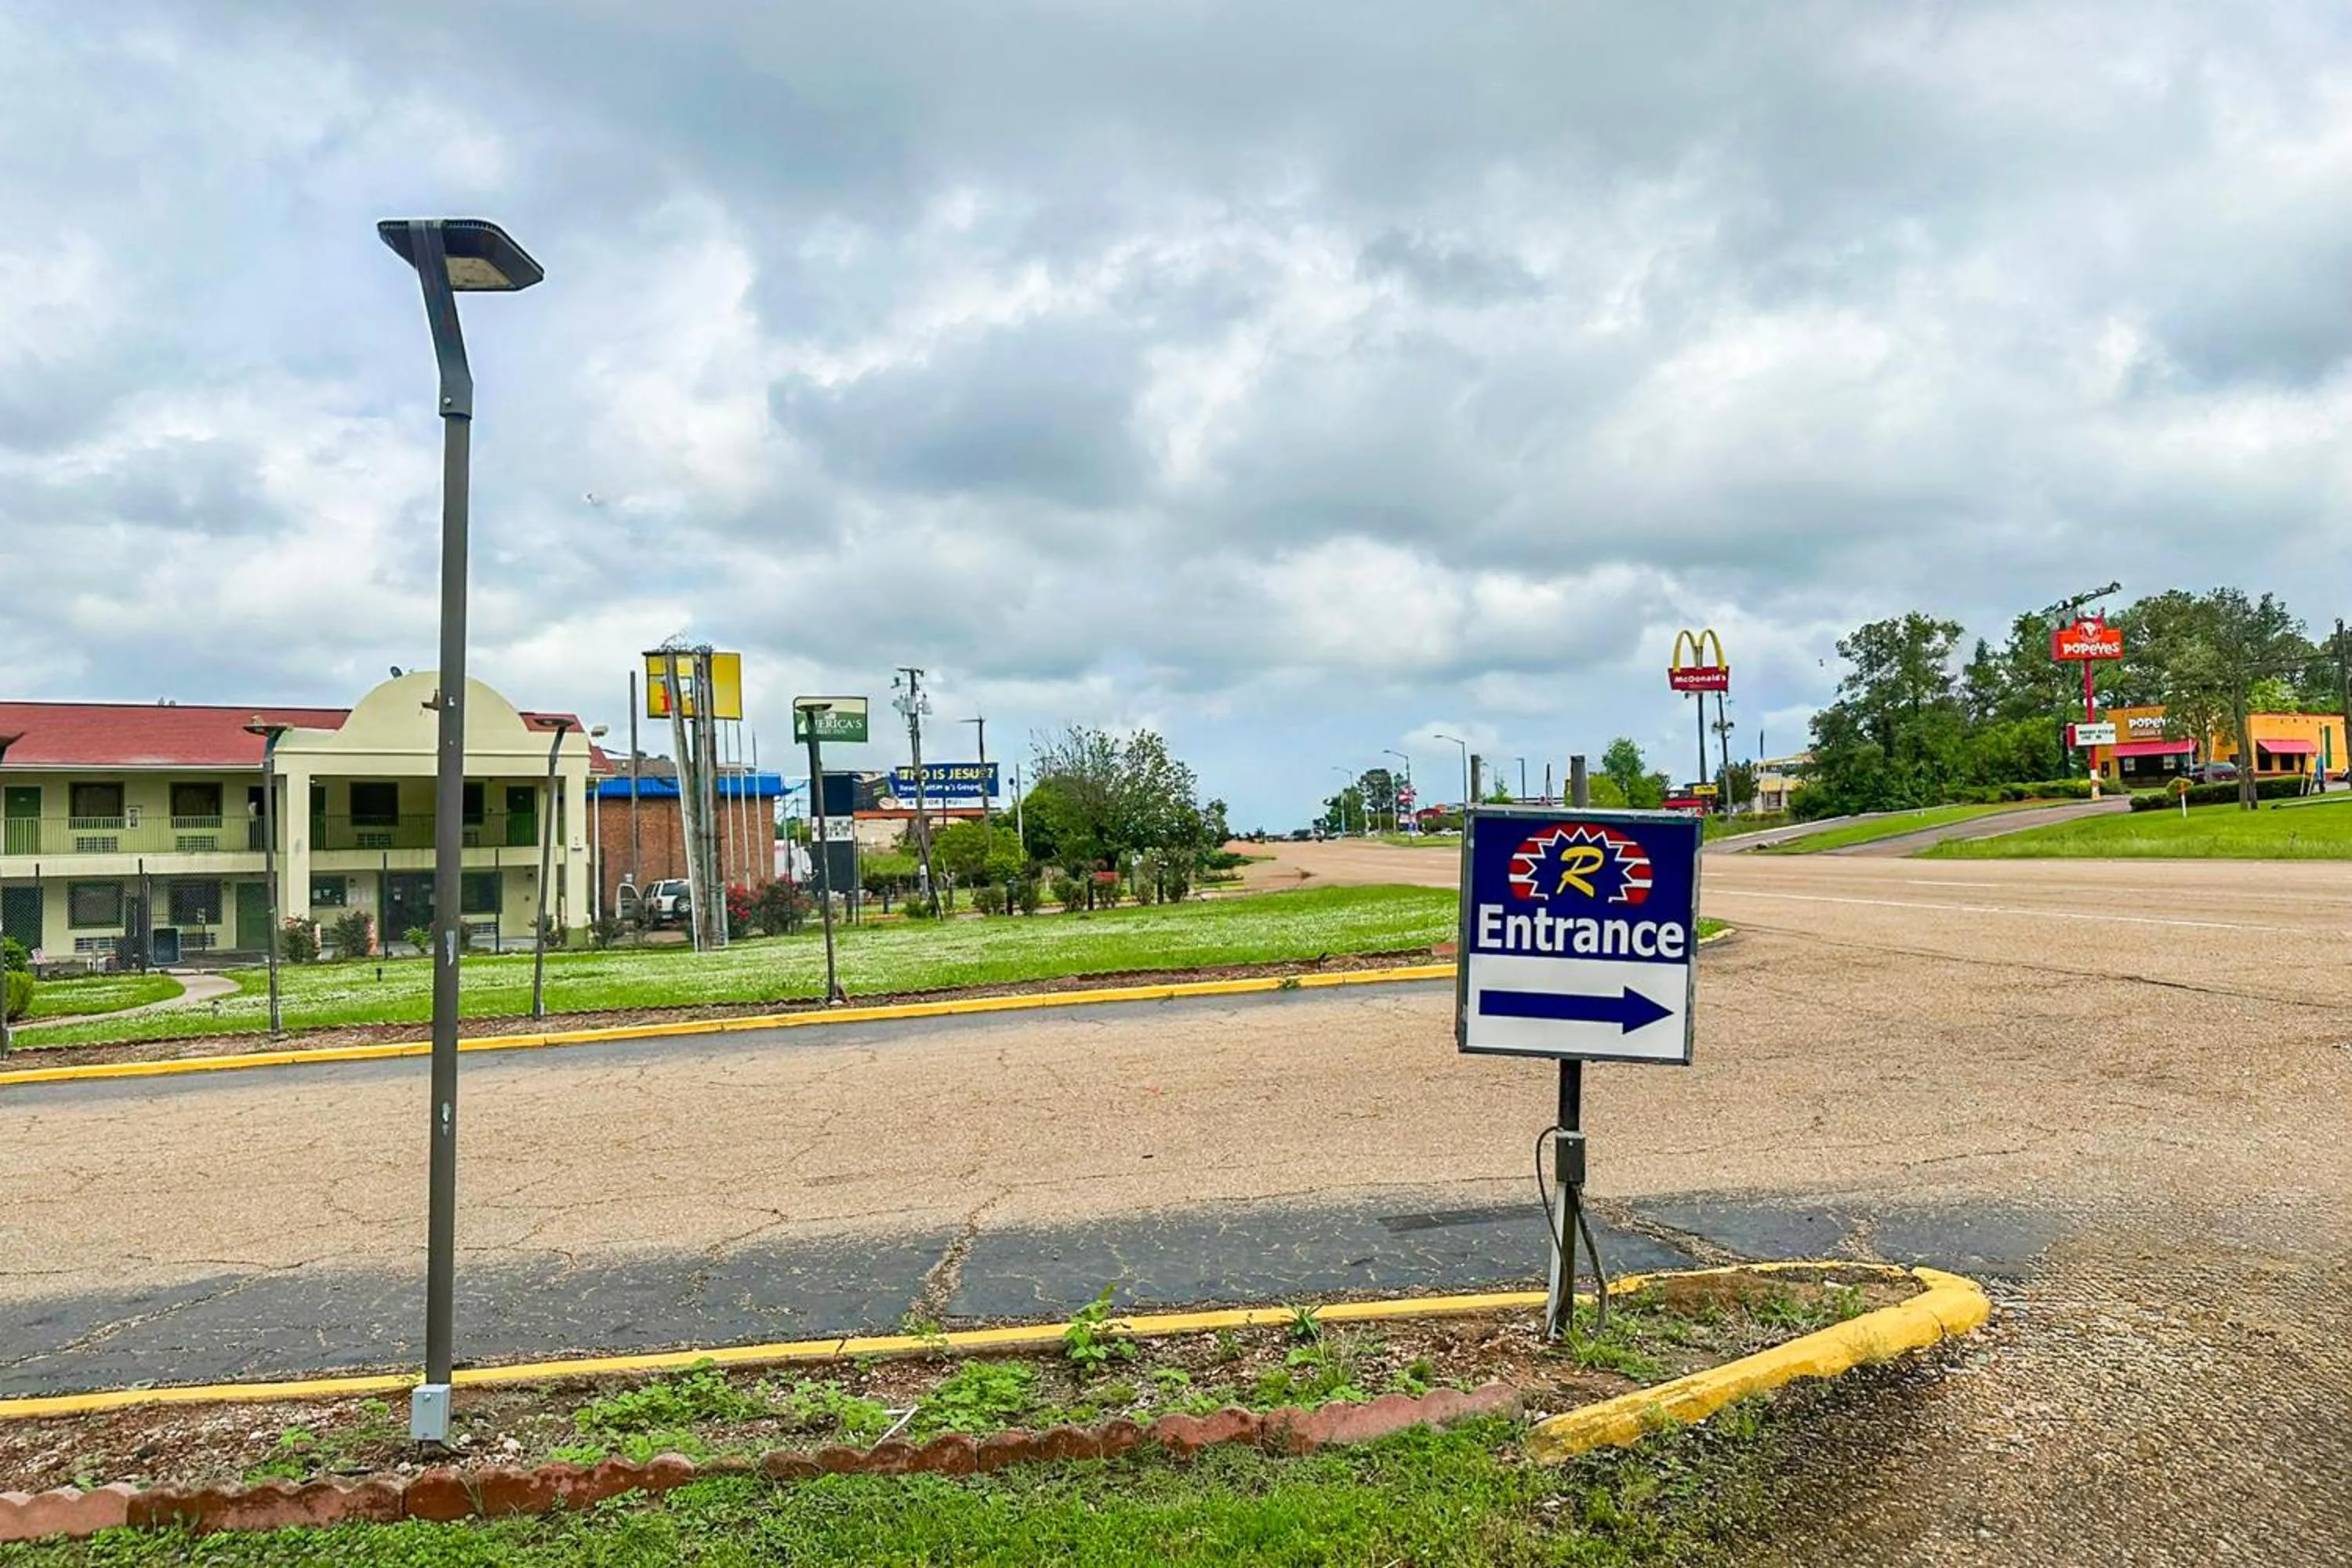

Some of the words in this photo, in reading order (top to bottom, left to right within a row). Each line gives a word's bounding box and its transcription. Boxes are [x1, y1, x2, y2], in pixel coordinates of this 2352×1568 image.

[1675, 674, 1726, 683] McDonald's
[814, 719, 863, 728] ERICA'S
[933, 768, 946, 780] IS
[948, 768, 994, 780] JESU?
[1556, 846, 1605, 898] R
[1478, 903, 1685, 958] Entrance
